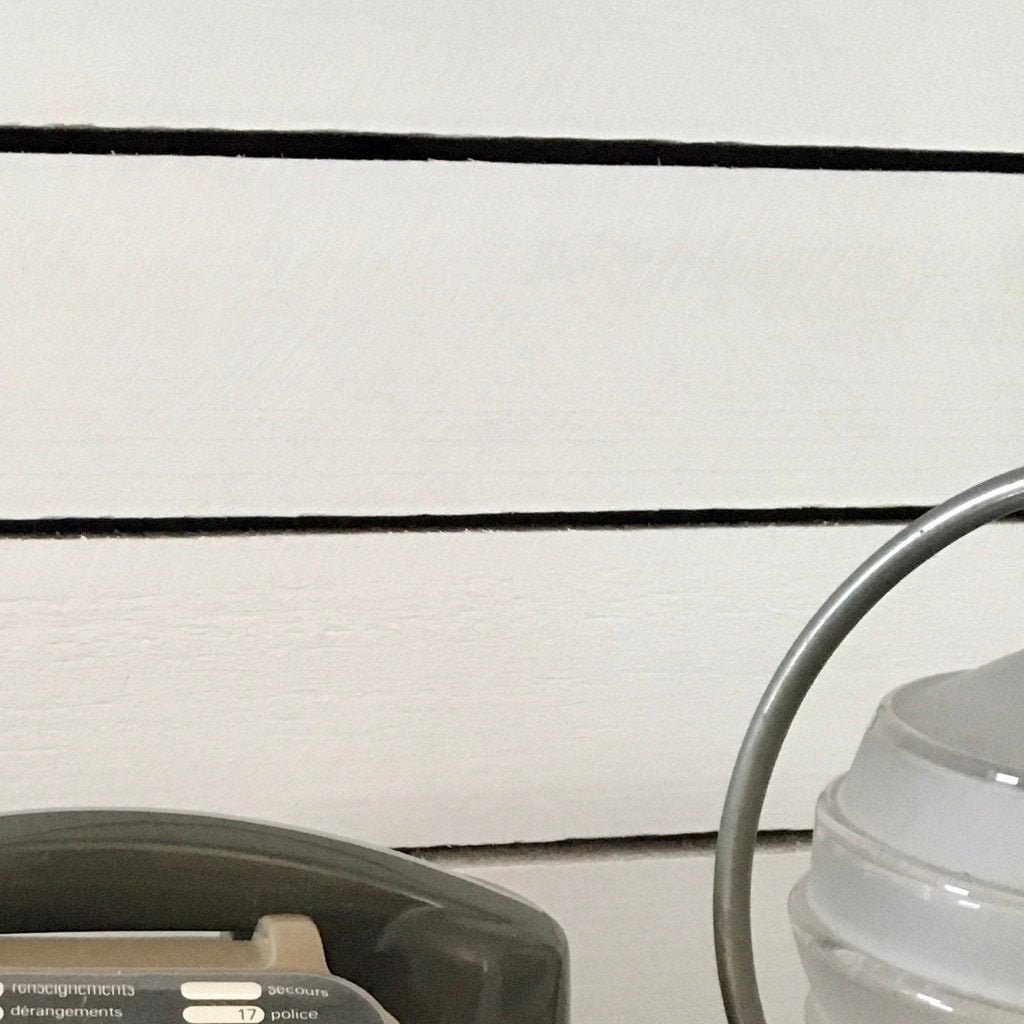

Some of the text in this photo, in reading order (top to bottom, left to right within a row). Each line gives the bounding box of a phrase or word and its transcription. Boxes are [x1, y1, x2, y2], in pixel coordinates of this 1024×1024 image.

[267, 984, 329, 998] secours
[10, 1004, 123, 1020] dérangements
[238, 1008, 319, 1022] 17 police
